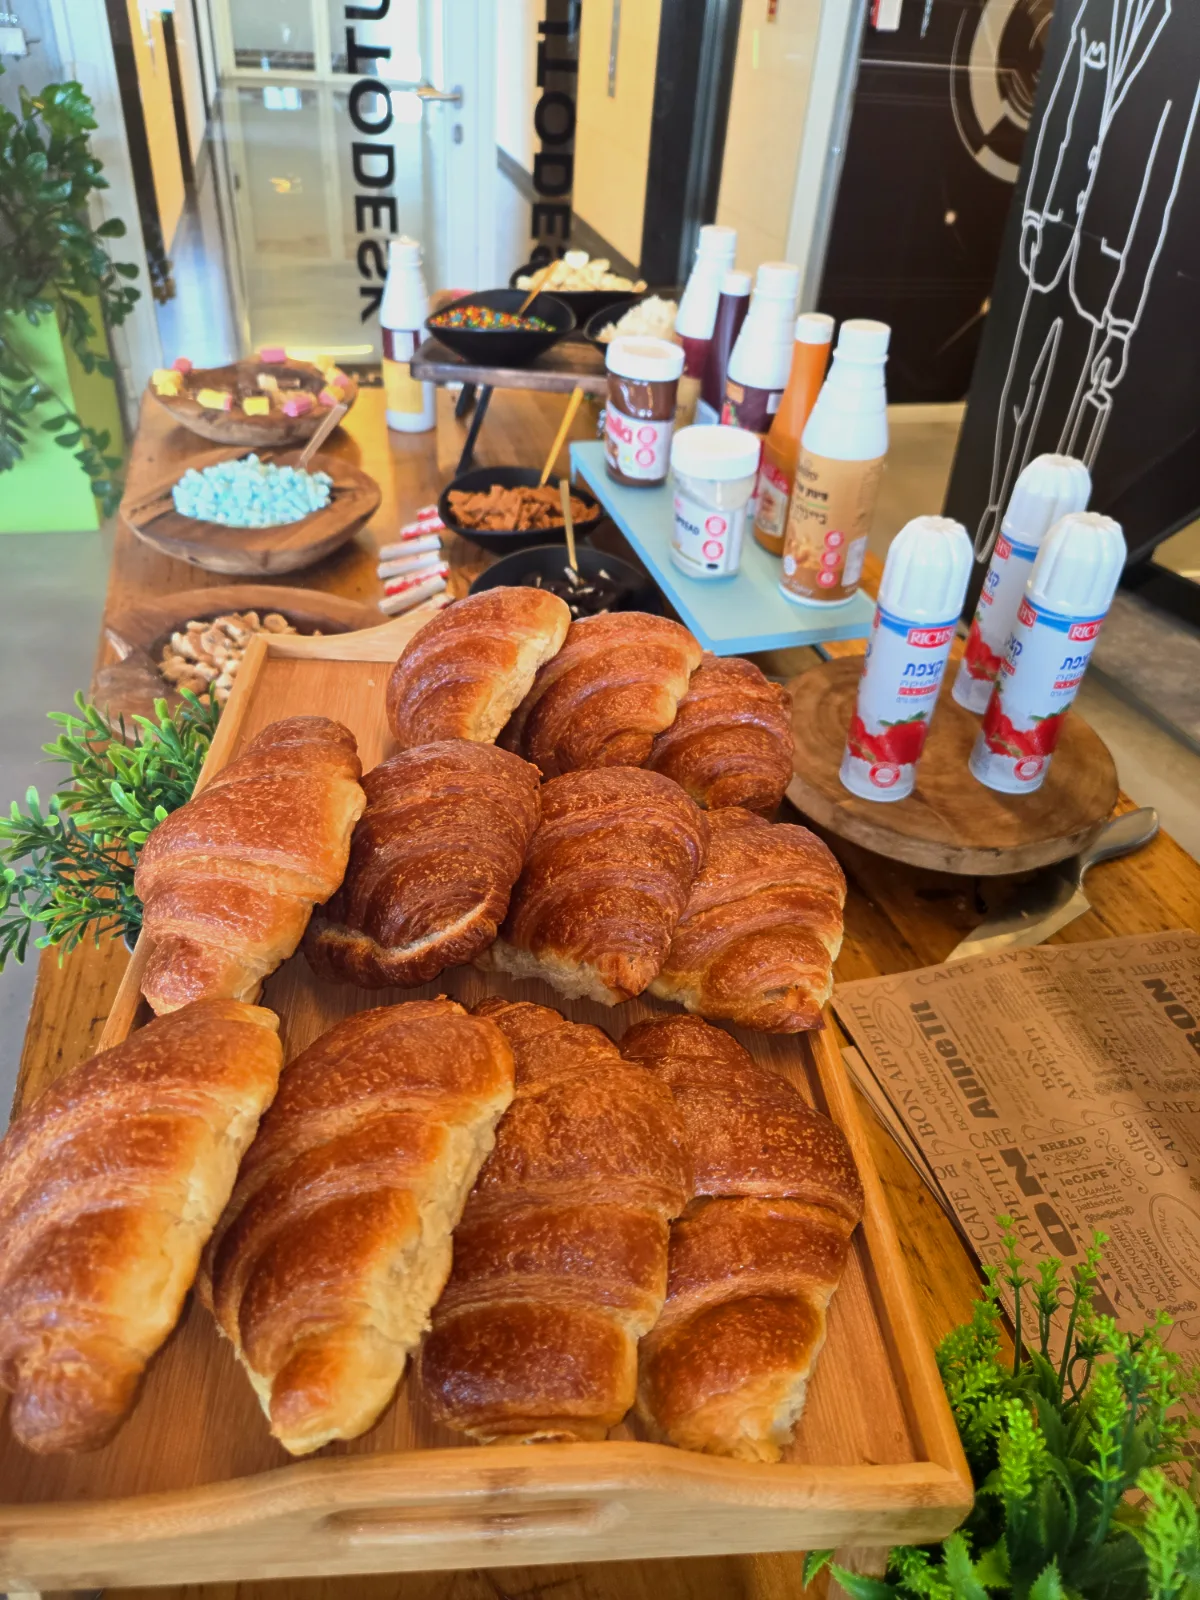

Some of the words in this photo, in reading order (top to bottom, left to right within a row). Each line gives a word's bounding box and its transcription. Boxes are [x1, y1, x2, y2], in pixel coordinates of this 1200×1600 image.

[915, 962, 975, 986] CAFE
[851, 1002, 905, 1084] APPETIT
[1023, 1026, 1083, 1101] APPETIT
[1024, 1048, 1057, 1092] BON
[895, 1071, 938, 1139] BON
[1146, 1100, 1200, 1113] CAFE
[968, 1127, 1017, 1150] CAFE
[1037, 1135, 1088, 1153] BREAD
[1121, 1119, 1165, 1177] Coffee
[1144, 1117, 1189, 1168] CAFE
[950, 1187, 991, 1243] CAFE
[976, 1152, 1051, 1257] APPETIT
[1073, 1194, 1126, 1214] patisserie
[1103, 1250, 1129, 1283] PARIS
[1108, 1222, 1167, 1304] BOULANGERIE
[1136, 1226, 1183, 1289] PATISSERIE
